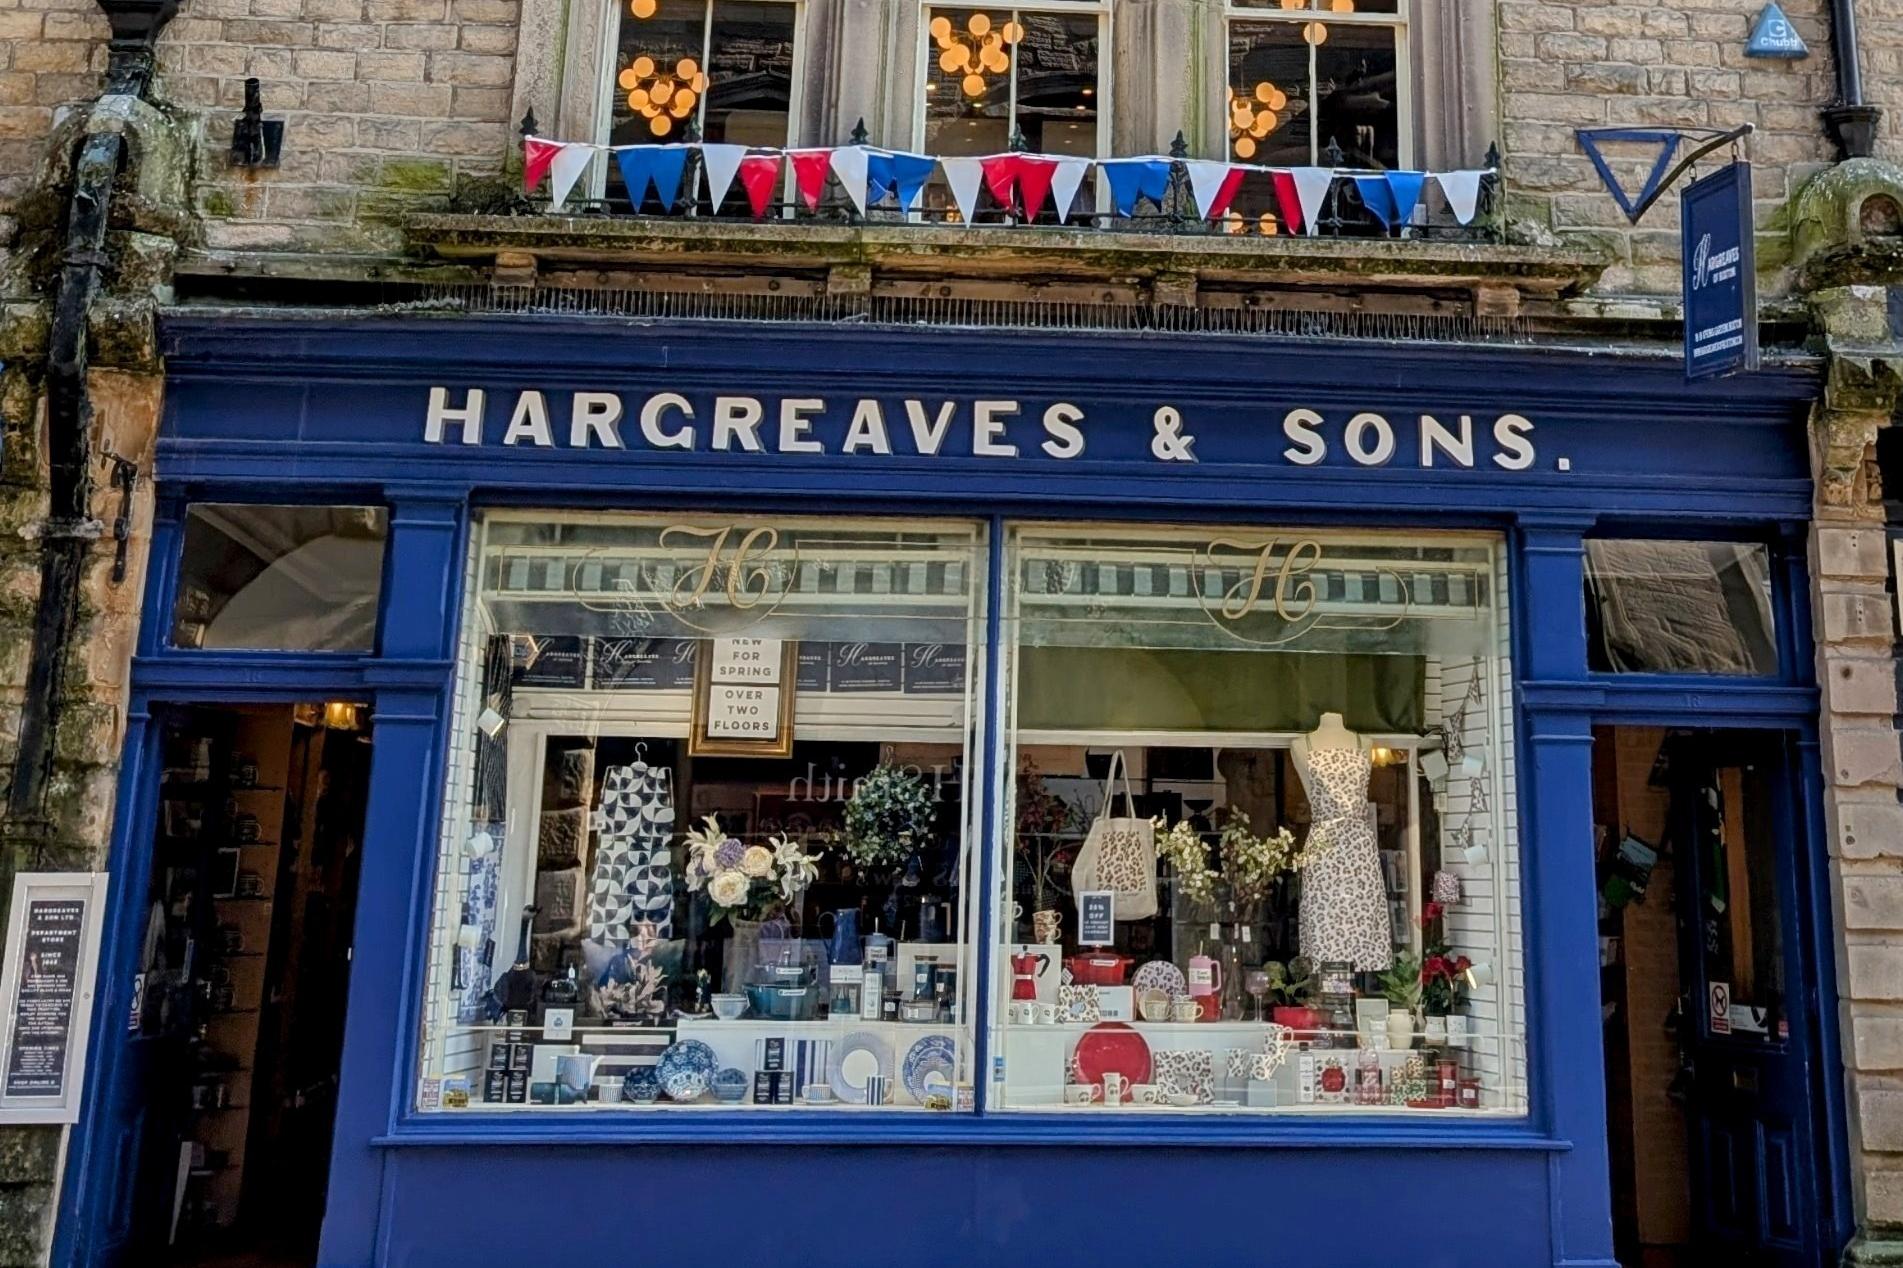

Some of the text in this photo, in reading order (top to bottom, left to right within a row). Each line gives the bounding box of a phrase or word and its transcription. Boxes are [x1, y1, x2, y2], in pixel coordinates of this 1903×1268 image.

[1760, 36, 1798, 47] Chubb
[424, 386, 1085, 459] HARGREAVES
[1151, 405, 1198, 463] &
[732, 651, 761, 661] FOR
[719, 666, 772, 677] SPRING
[724, 689, 763, 700] OVER
[727, 705, 759, 716] TWO
[713, 720, 770, 731] FLOORS
